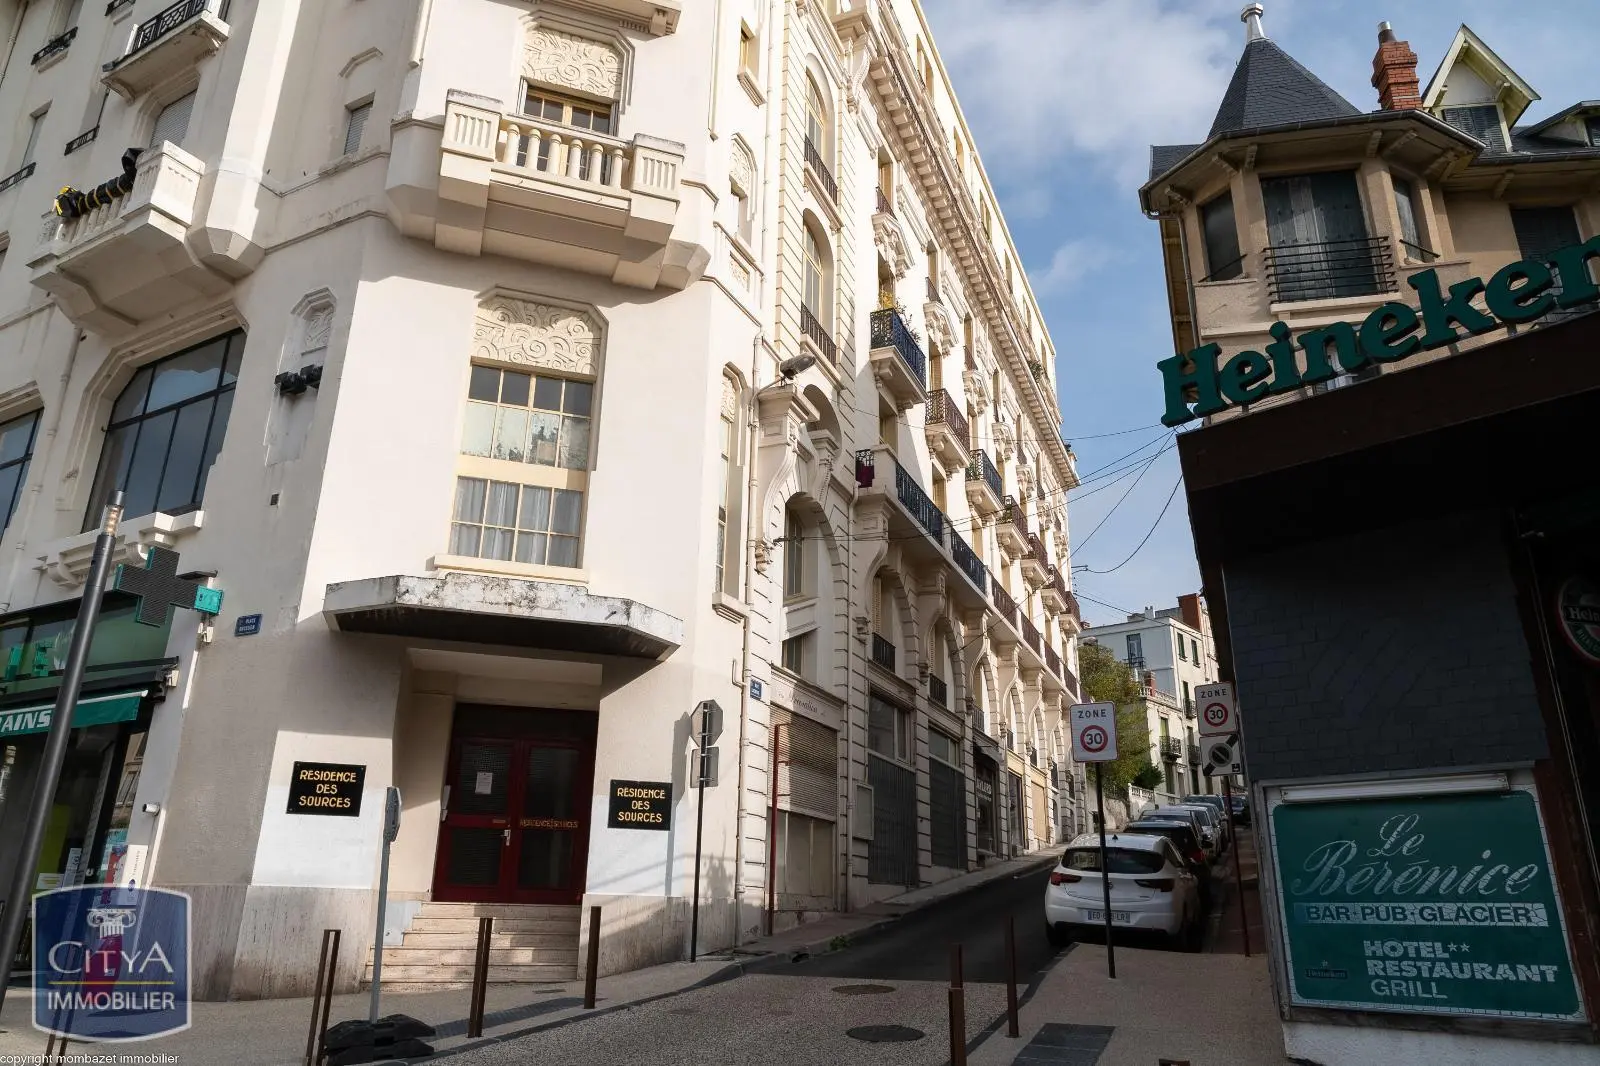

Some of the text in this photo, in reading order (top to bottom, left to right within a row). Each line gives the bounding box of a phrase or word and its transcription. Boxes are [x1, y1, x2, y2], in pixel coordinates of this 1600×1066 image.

[1200, 688, 1228, 698] ZONE
[1078, 709, 1107, 719] ZONE
[1209, 709, 1224, 720] 30
[0, 710, 52, 733] AINS
[1086, 733, 1102, 745] 30
[300, 769, 357, 782] RESIDENCE
[316, 784, 338, 794] DES
[617, 787, 666, 799] RESIDENCE
[299, 796, 351, 808] SOURCES
[631, 800, 650, 810] DES
[618, 811, 662, 823] SOURCES
[1367, 813, 1424, 857] Le
[1290, 840, 1539, 896] Bérénice
[1366, 960, 1558, 983] RESTAURANT
[1370, 978, 1448, 999] GRILL
